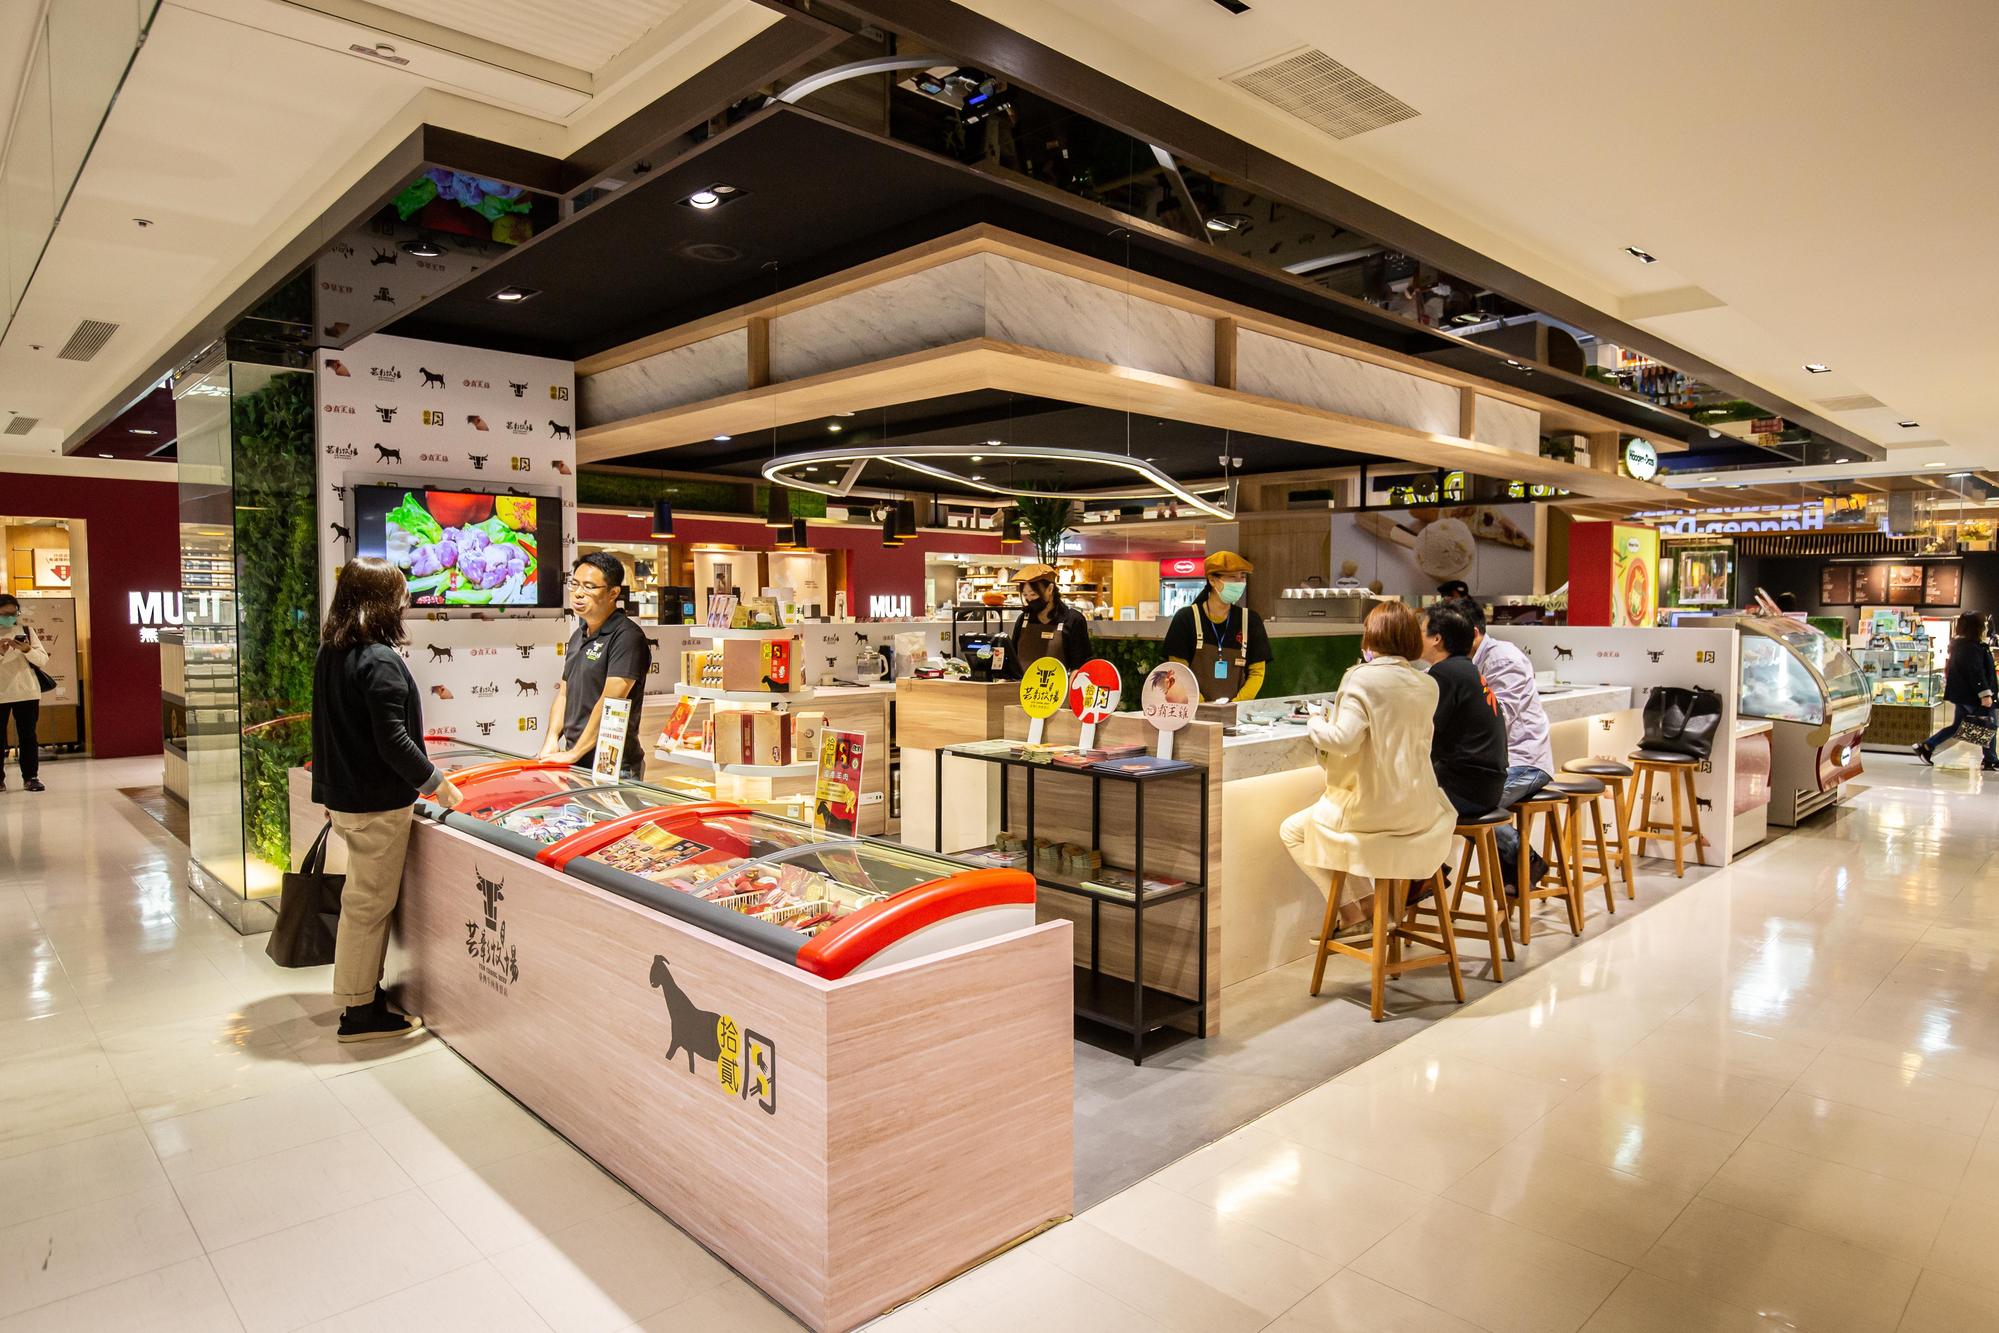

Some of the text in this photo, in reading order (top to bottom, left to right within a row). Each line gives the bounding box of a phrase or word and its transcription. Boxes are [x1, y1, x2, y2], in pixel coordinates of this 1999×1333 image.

[129, 591, 220, 625] MUJI
[870, 596, 911, 617] MUJI
[465, 919, 519, 985] 芸彰牧場
